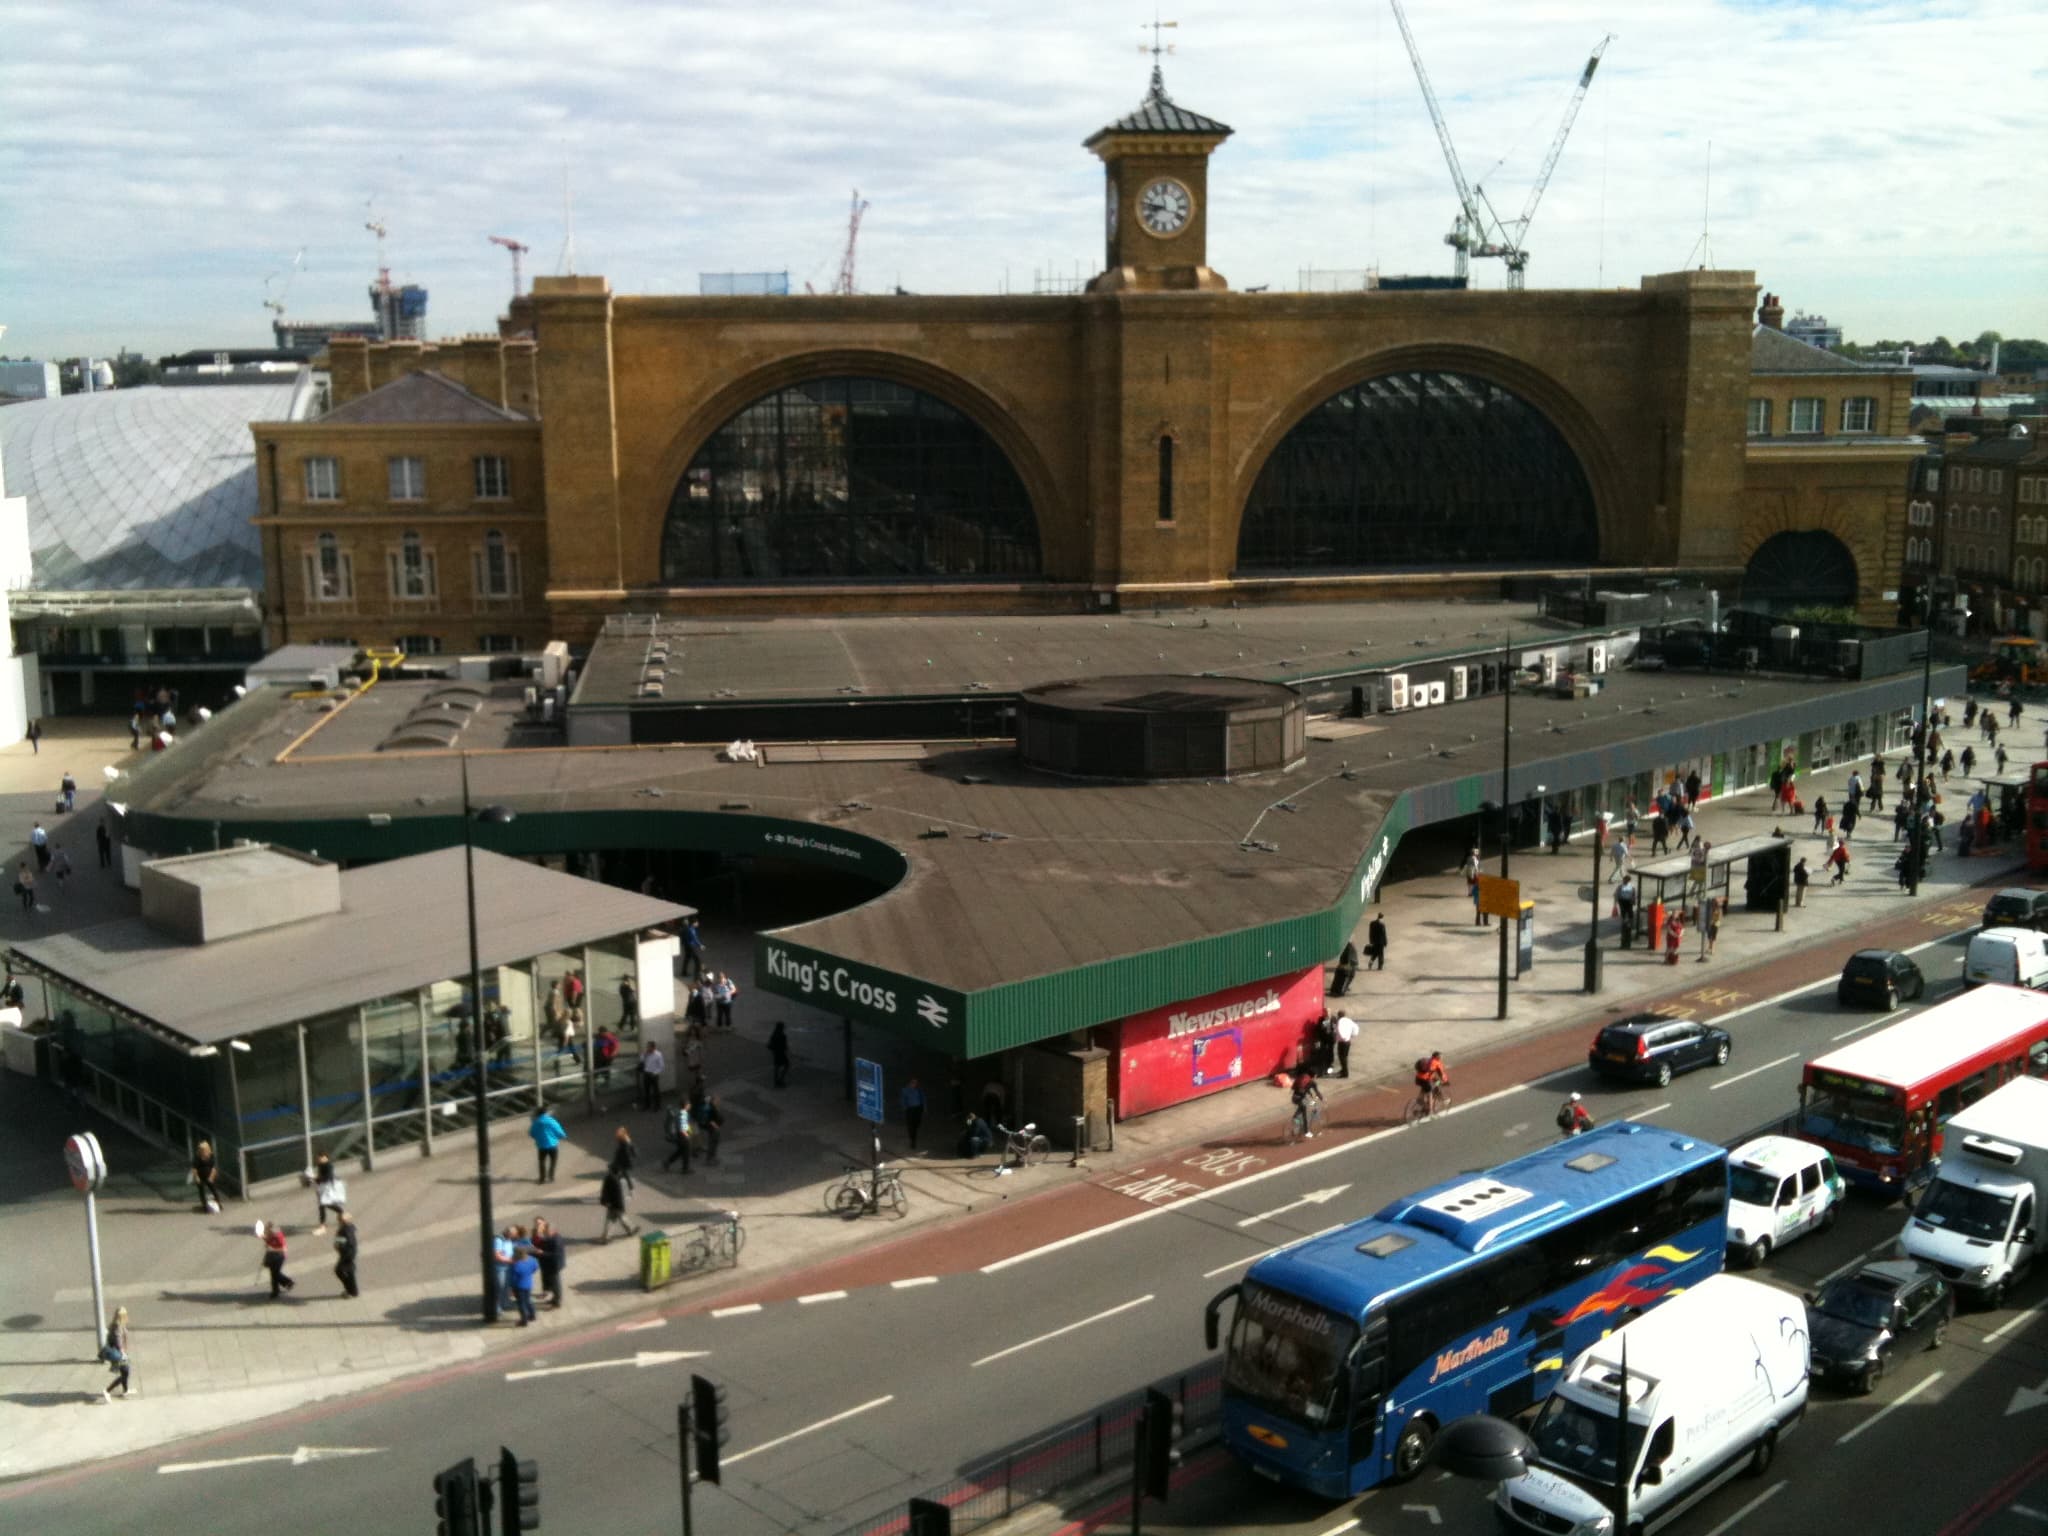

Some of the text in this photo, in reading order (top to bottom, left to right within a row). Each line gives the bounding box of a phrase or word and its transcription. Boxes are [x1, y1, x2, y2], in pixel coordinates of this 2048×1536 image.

[809, 838, 828, 852] Cross
[767, 947, 897, 1014] King's Cross
[1167, 988, 1281, 1039] Newsweek
[1182, 1147, 1267, 1177] BUS
[1101, 1168, 1206, 1207] LANE
[1250, 1289, 1332, 1336] Marshalls
[1428, 1325, 1510, 1384] Marshalls
